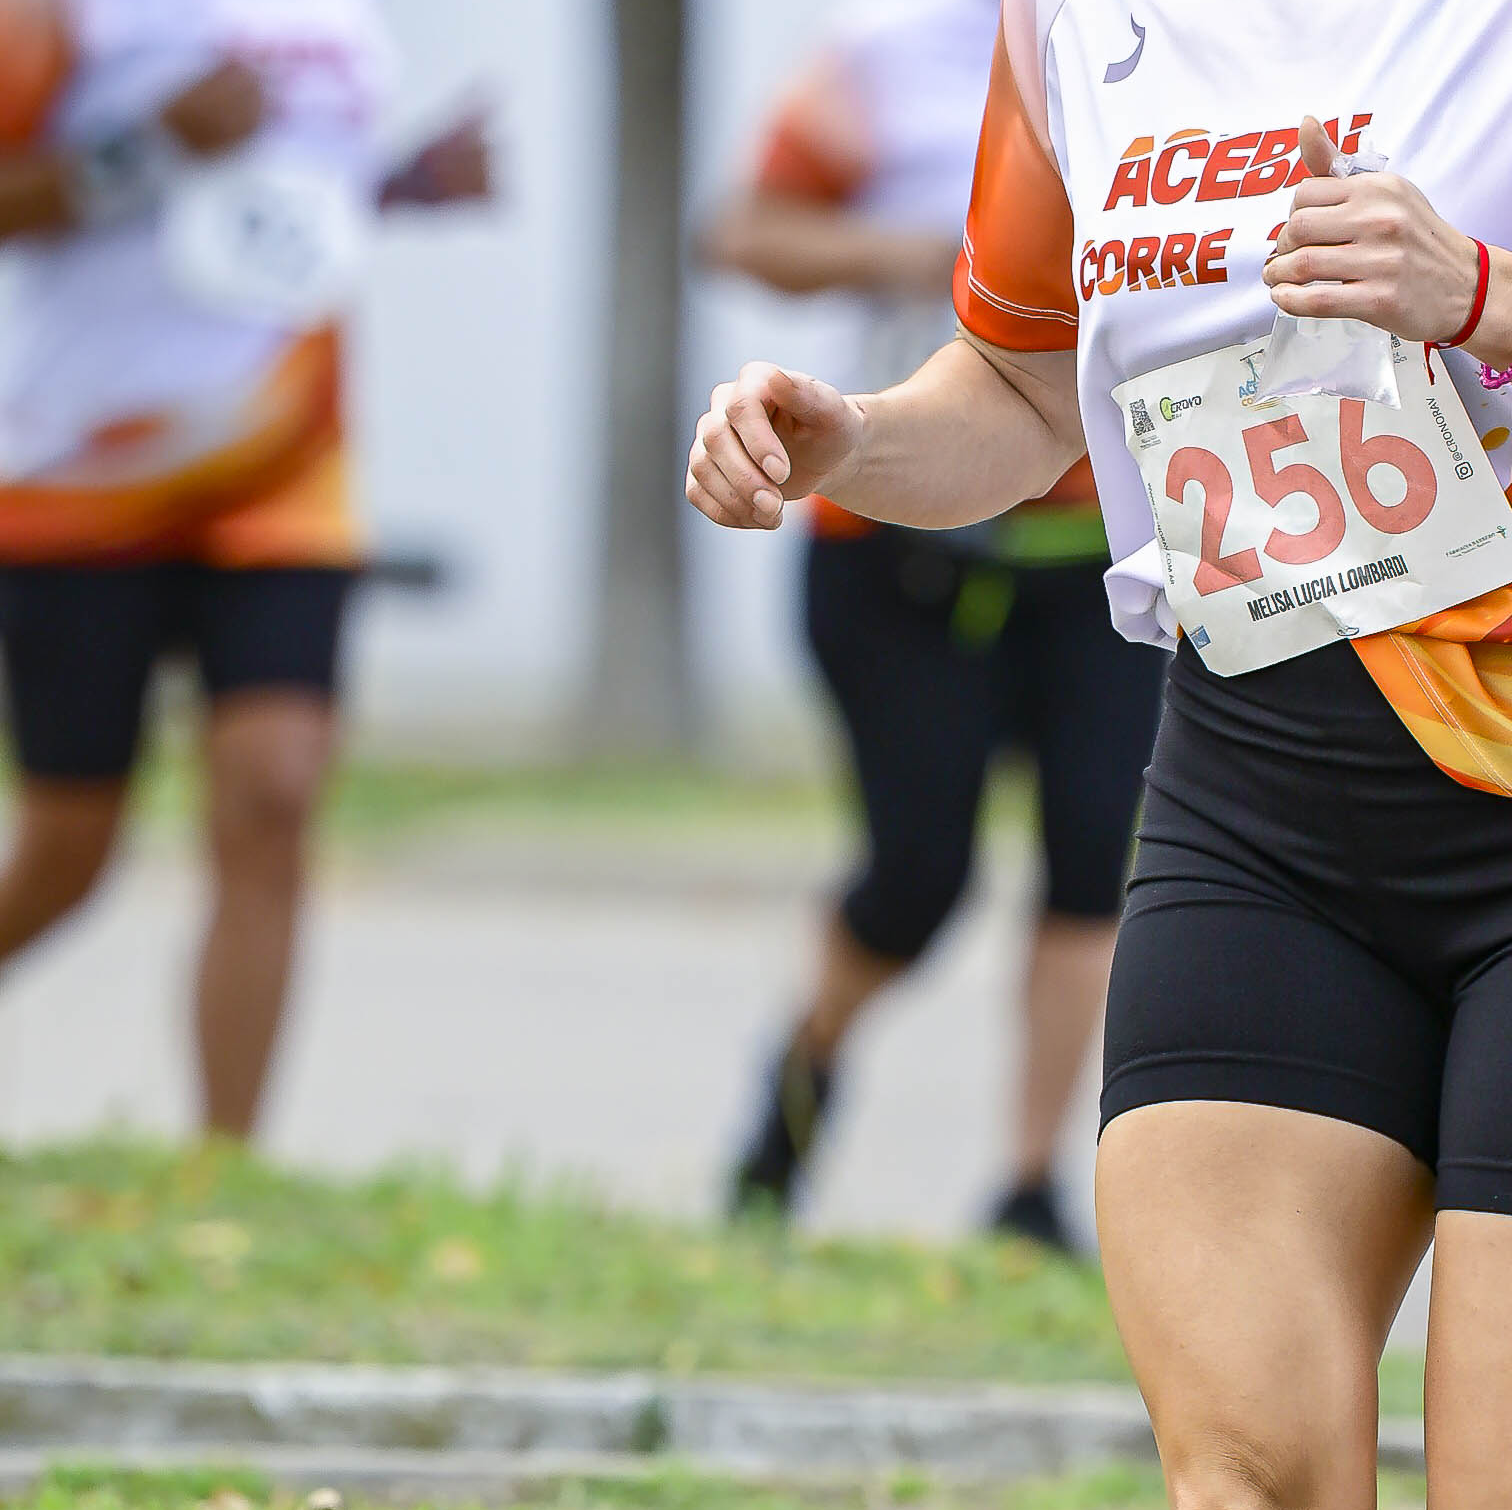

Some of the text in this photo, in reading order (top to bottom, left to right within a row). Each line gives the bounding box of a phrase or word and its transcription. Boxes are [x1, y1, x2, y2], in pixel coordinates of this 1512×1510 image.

[1080, 228, 1234, 301] CORRE
[1426, 397, 1463, 462] @CRONORAV
[1166, 398, 1437, 597] 256
[1247, 554, 1409, 622] MELISA LUCIA LOMBARDI
